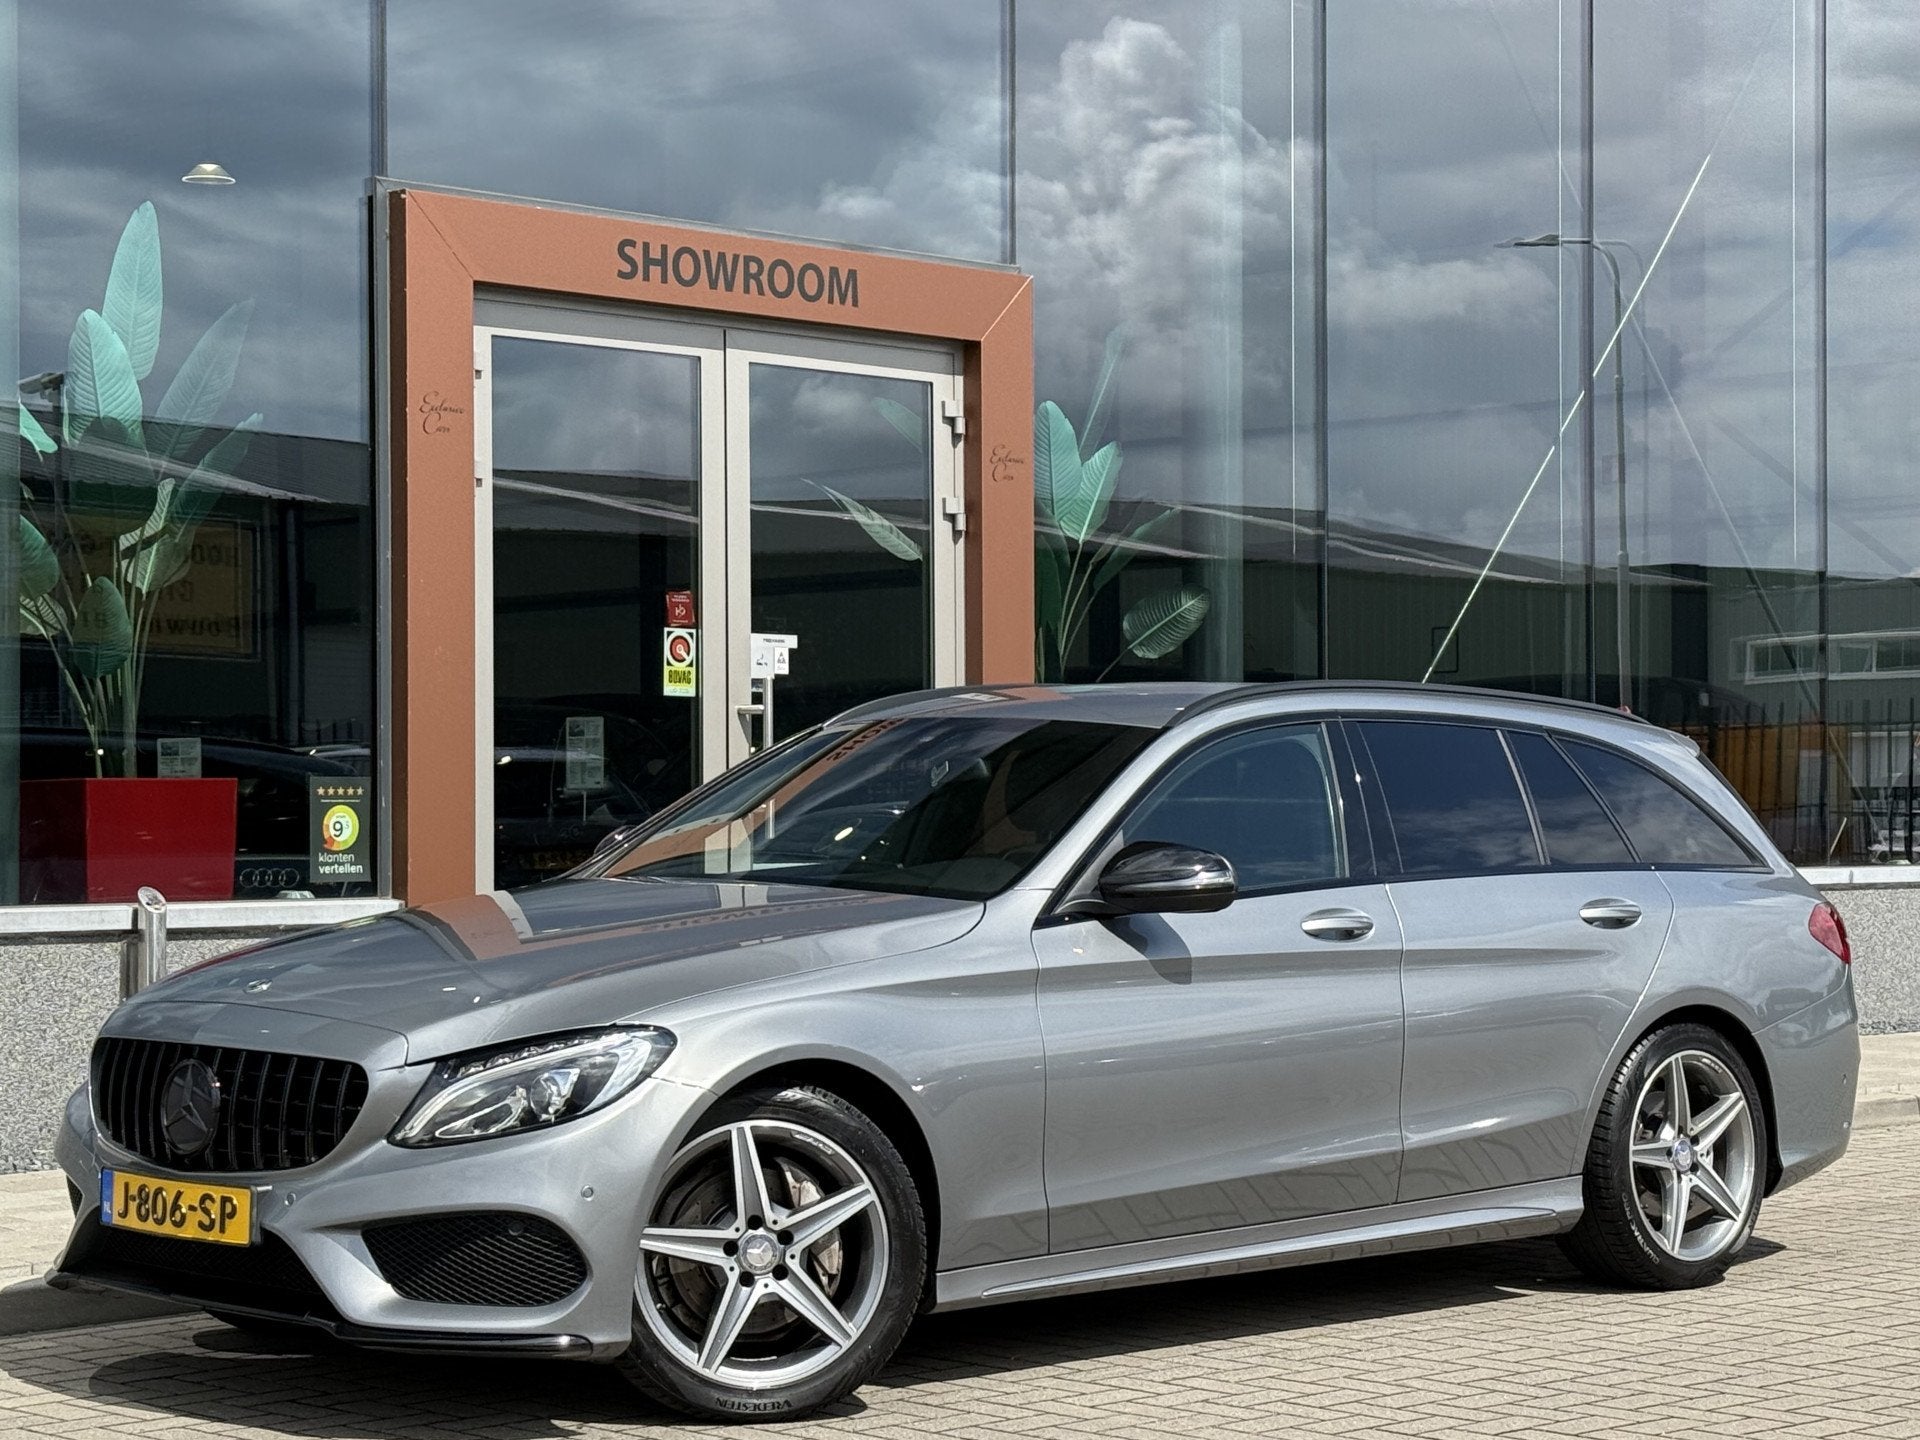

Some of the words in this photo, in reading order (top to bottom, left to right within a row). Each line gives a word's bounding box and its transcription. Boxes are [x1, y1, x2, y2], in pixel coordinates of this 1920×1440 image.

[617, 238, 859, 308] SHOWROOM
[668, 669, 692, 685] BOVAG
[318, 852, 355, 863] klanten
[318, 863, 363, 875] vertellen
[117, 1181, 238, 1234] J-806-SP
[715, 1397, 793, 1412] VREDESTEIN
